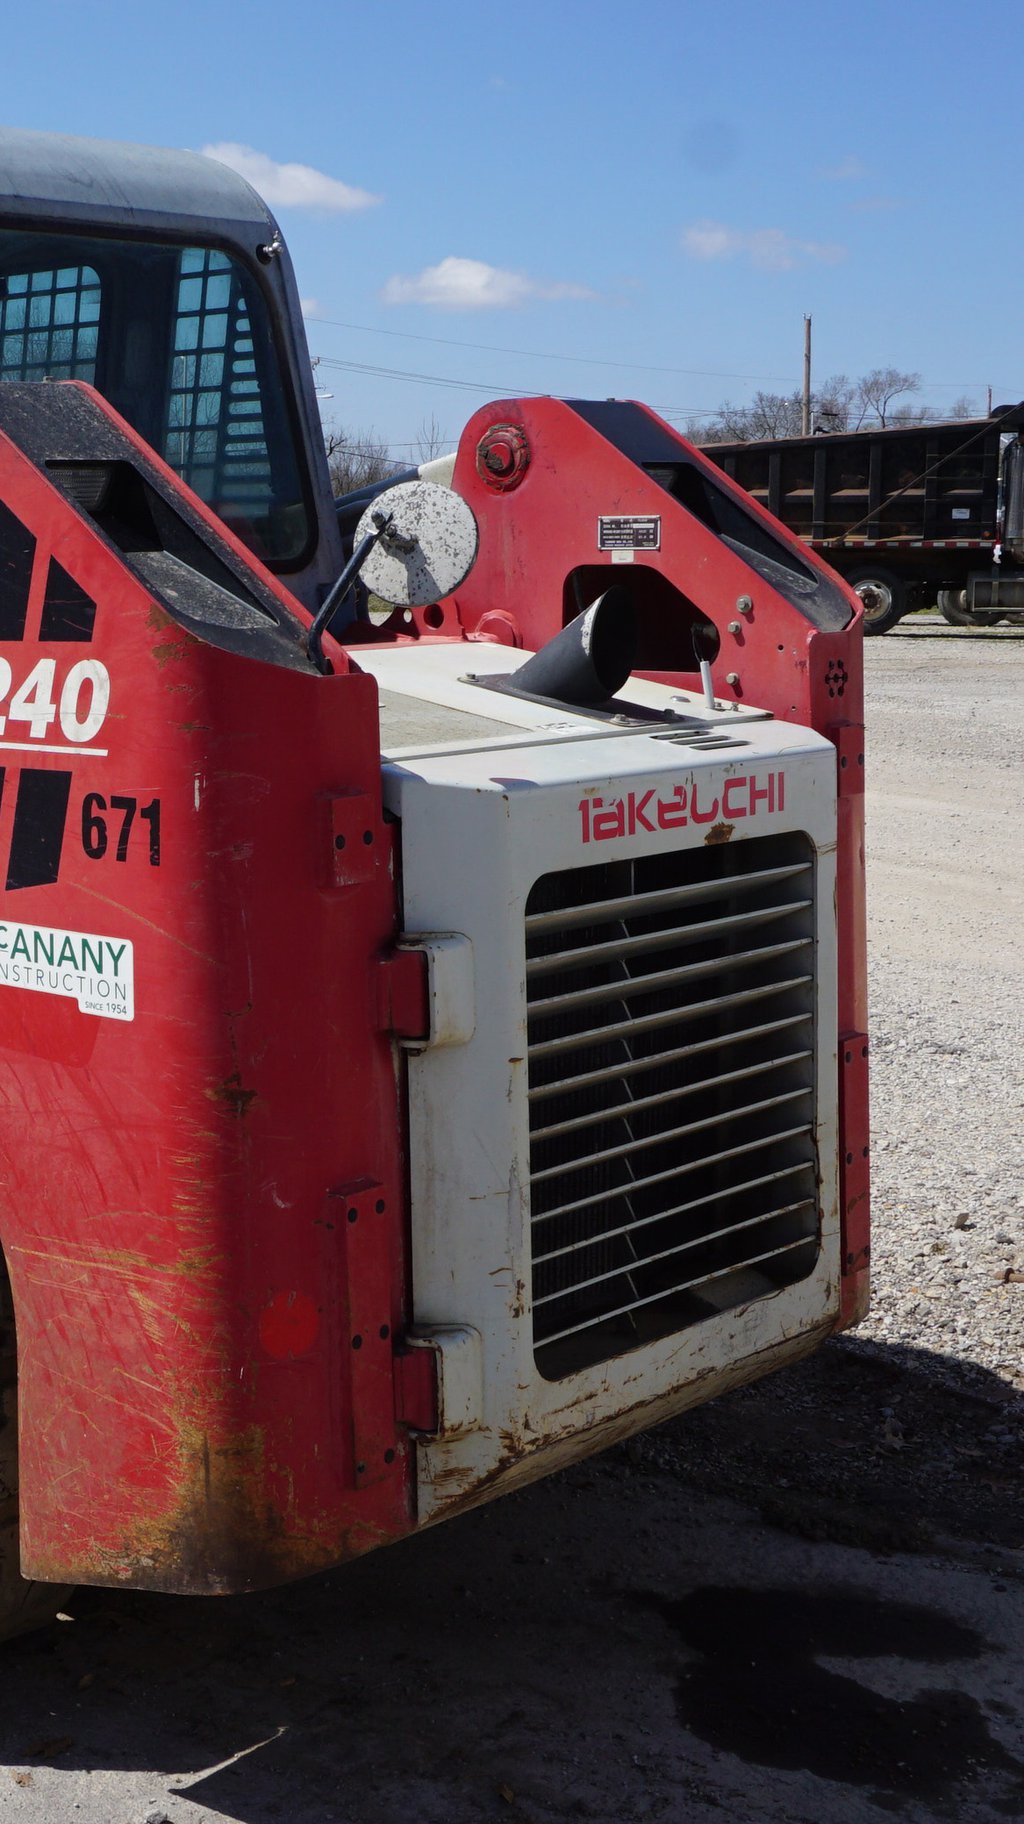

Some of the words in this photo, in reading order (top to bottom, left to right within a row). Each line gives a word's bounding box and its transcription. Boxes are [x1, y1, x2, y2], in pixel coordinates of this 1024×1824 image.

[81, 792, 161, 867] 671
[84, 1001, 104, 1011] SINCE
[106, 1002, 128, 1015] 1954
